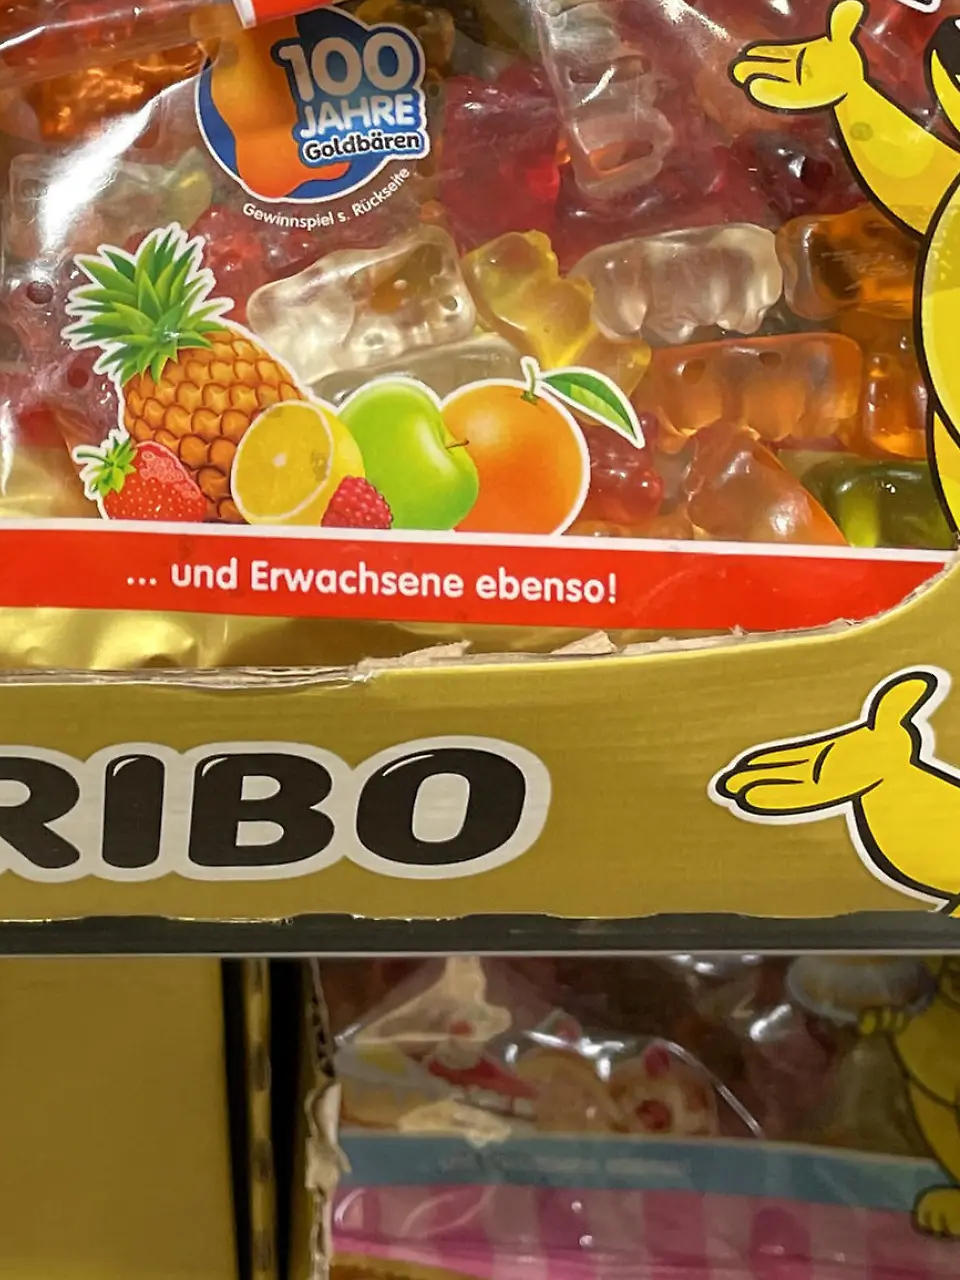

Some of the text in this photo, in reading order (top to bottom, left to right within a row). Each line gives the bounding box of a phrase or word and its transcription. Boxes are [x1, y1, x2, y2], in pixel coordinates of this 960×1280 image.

[278, 31, 416, 103] 100
[300, 93, 416, 139] JAHRE
[304, 131, 420, 161] Goldbären
[242, 166, 411, 232] Gewinnspiel s. Rückseite
[171, 557, 238, 589] und
[250, 559, 464, 600] Erwachsene
[475, 566, 617, 605] ebenso!
